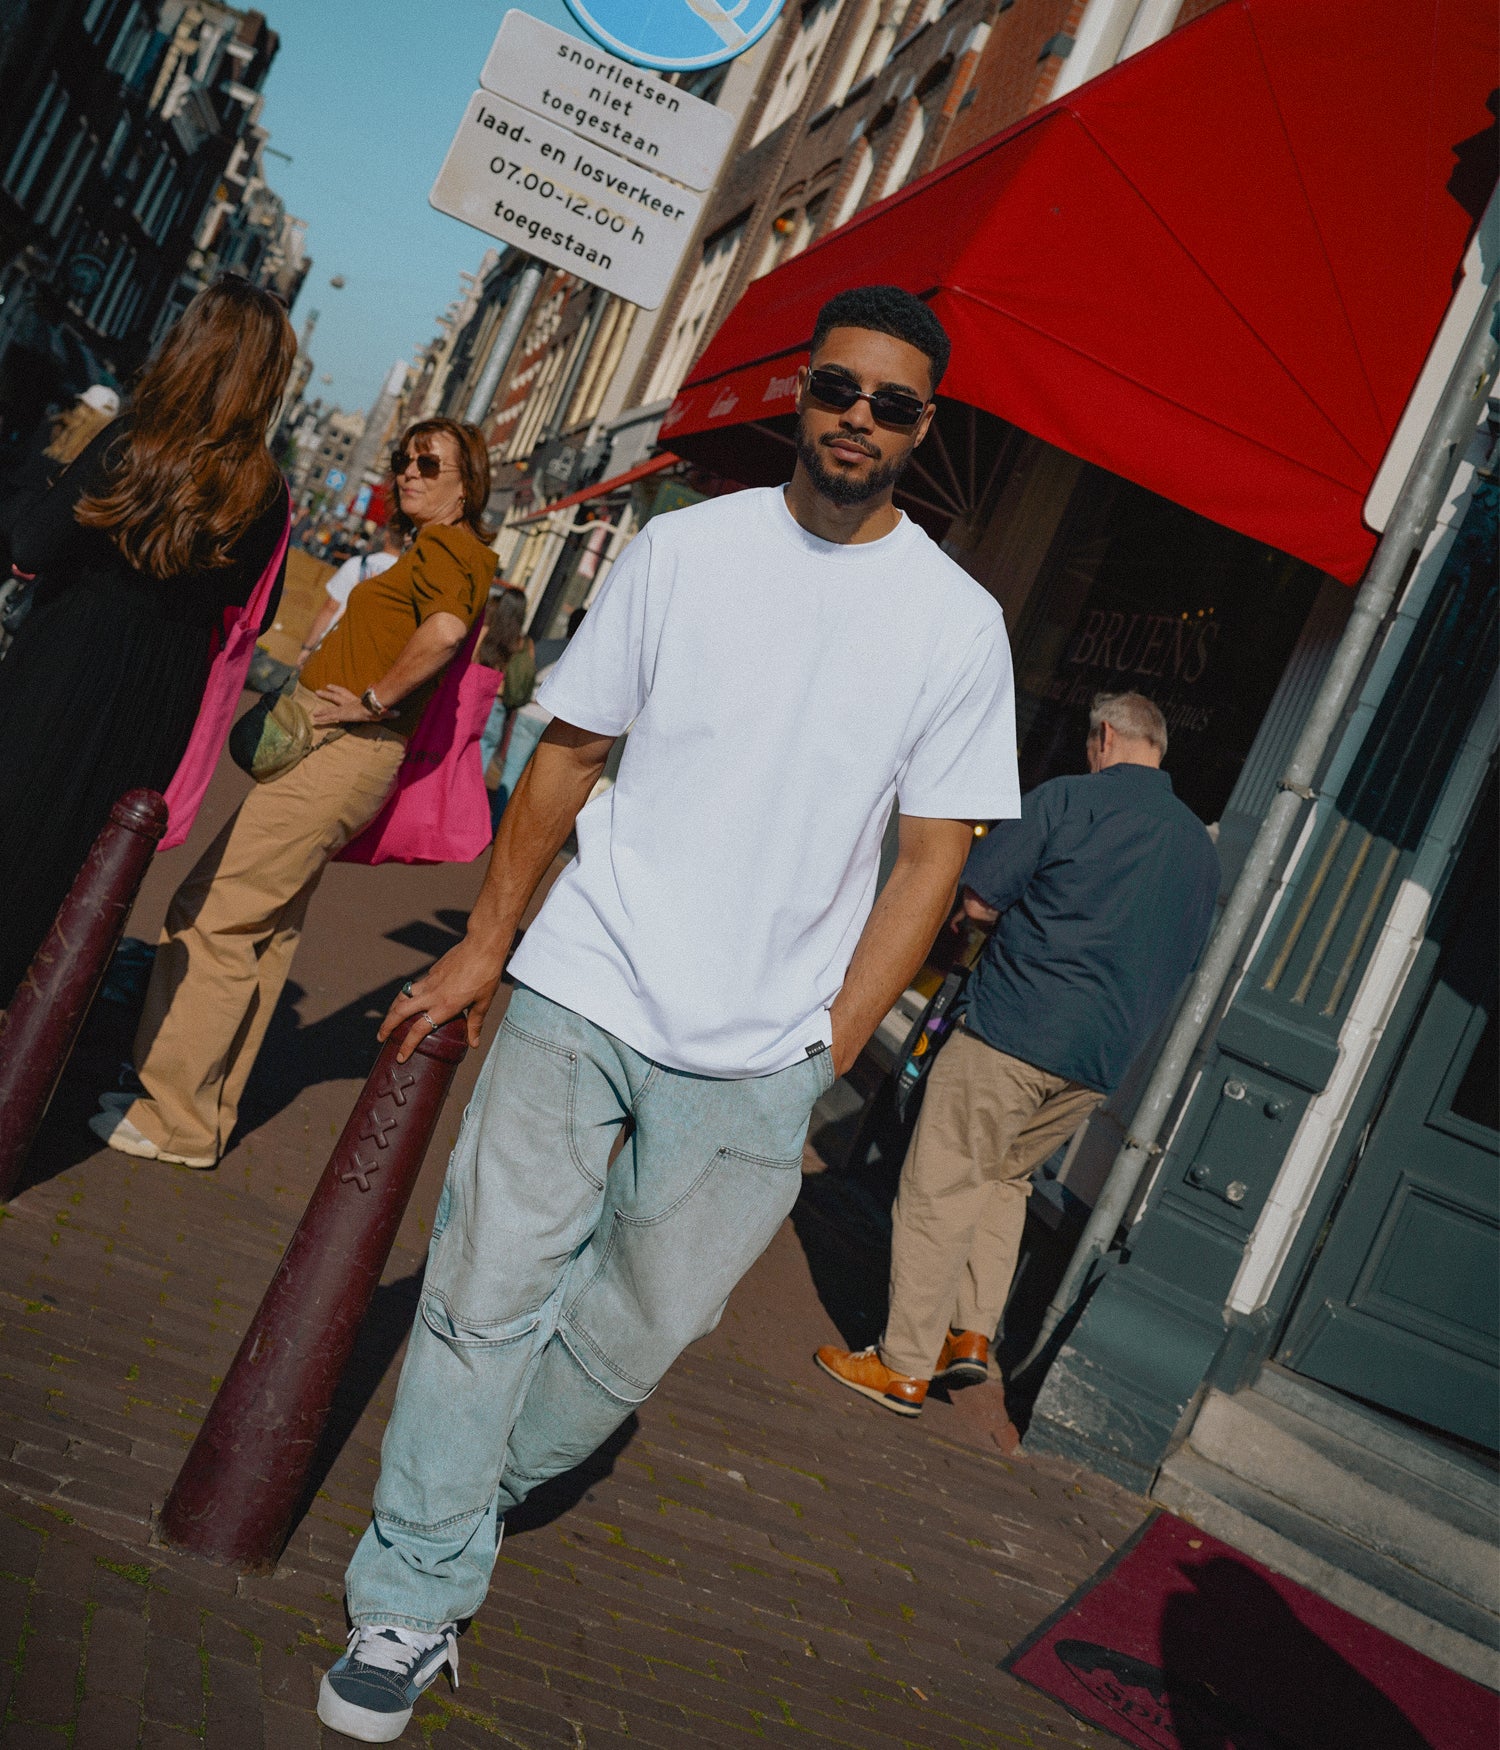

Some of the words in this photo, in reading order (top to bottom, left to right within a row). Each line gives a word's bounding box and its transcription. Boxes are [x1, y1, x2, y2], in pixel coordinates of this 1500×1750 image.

[558, 43, 681, 113] snorfietsen
[588, 86, 633, 117] niet
[541, 88, 661, 157] toegestaan
[476, 107, 532, 144] laad-
[540, 140, 567, 164] en
[573, 156, 685, 221] losverkeer
[490, 156, 626, 234] 07.00-12.00
[631, 225, 645, 245] h
[495, 200, 613, 270] toegestaan
